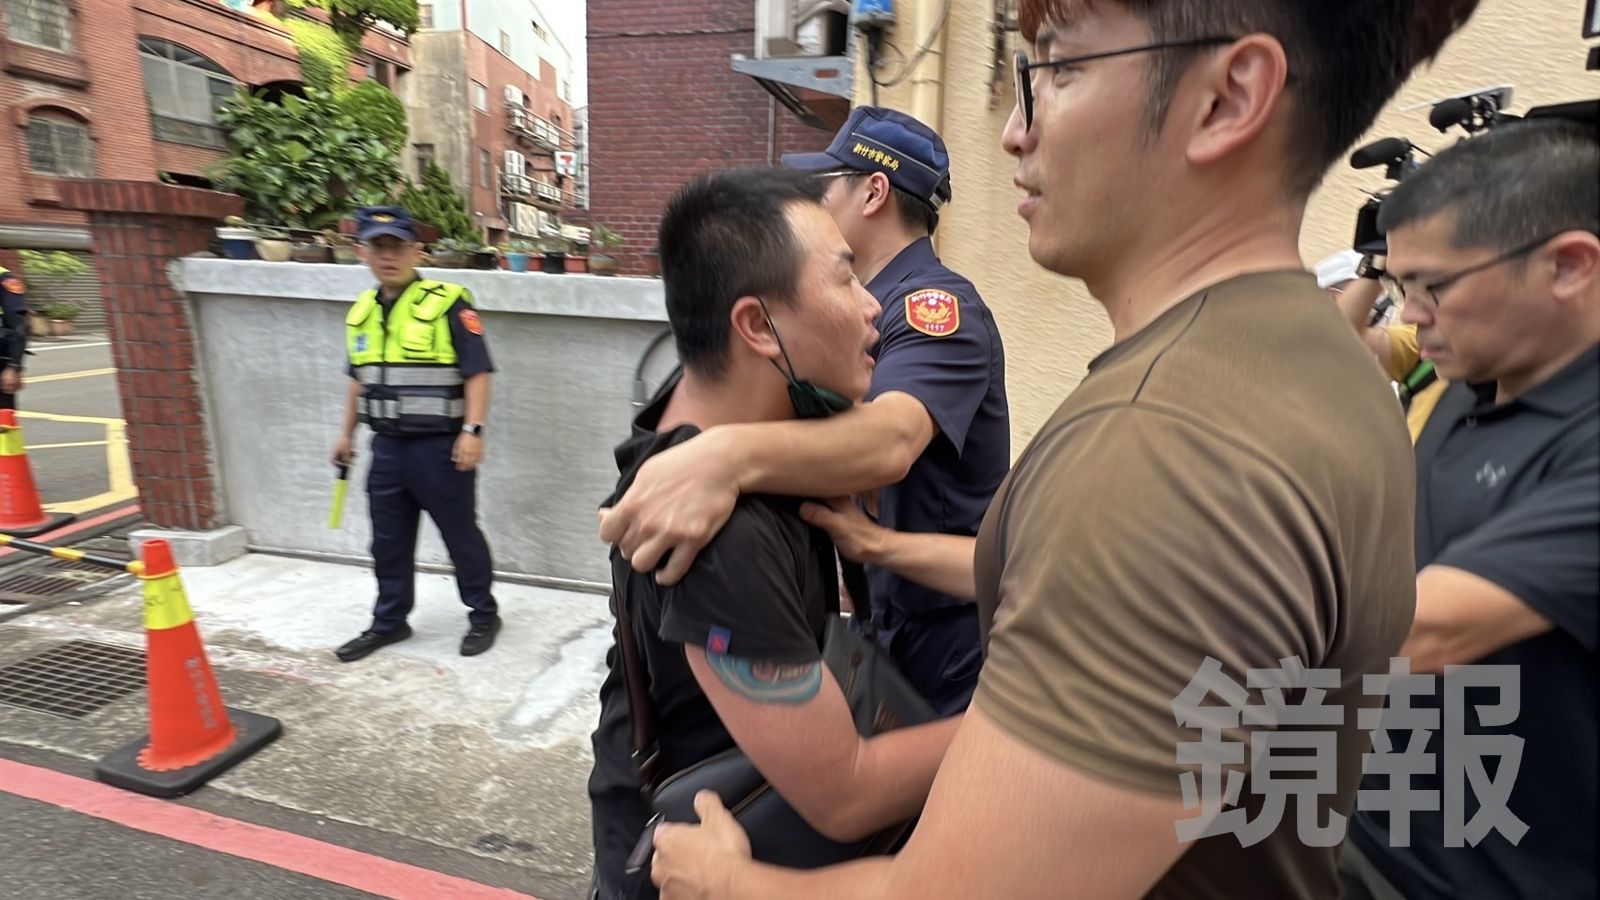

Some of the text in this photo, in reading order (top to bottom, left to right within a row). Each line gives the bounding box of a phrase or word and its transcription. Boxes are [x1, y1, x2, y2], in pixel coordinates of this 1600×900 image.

[853, 142, 900, 172] 新竹市警察局
